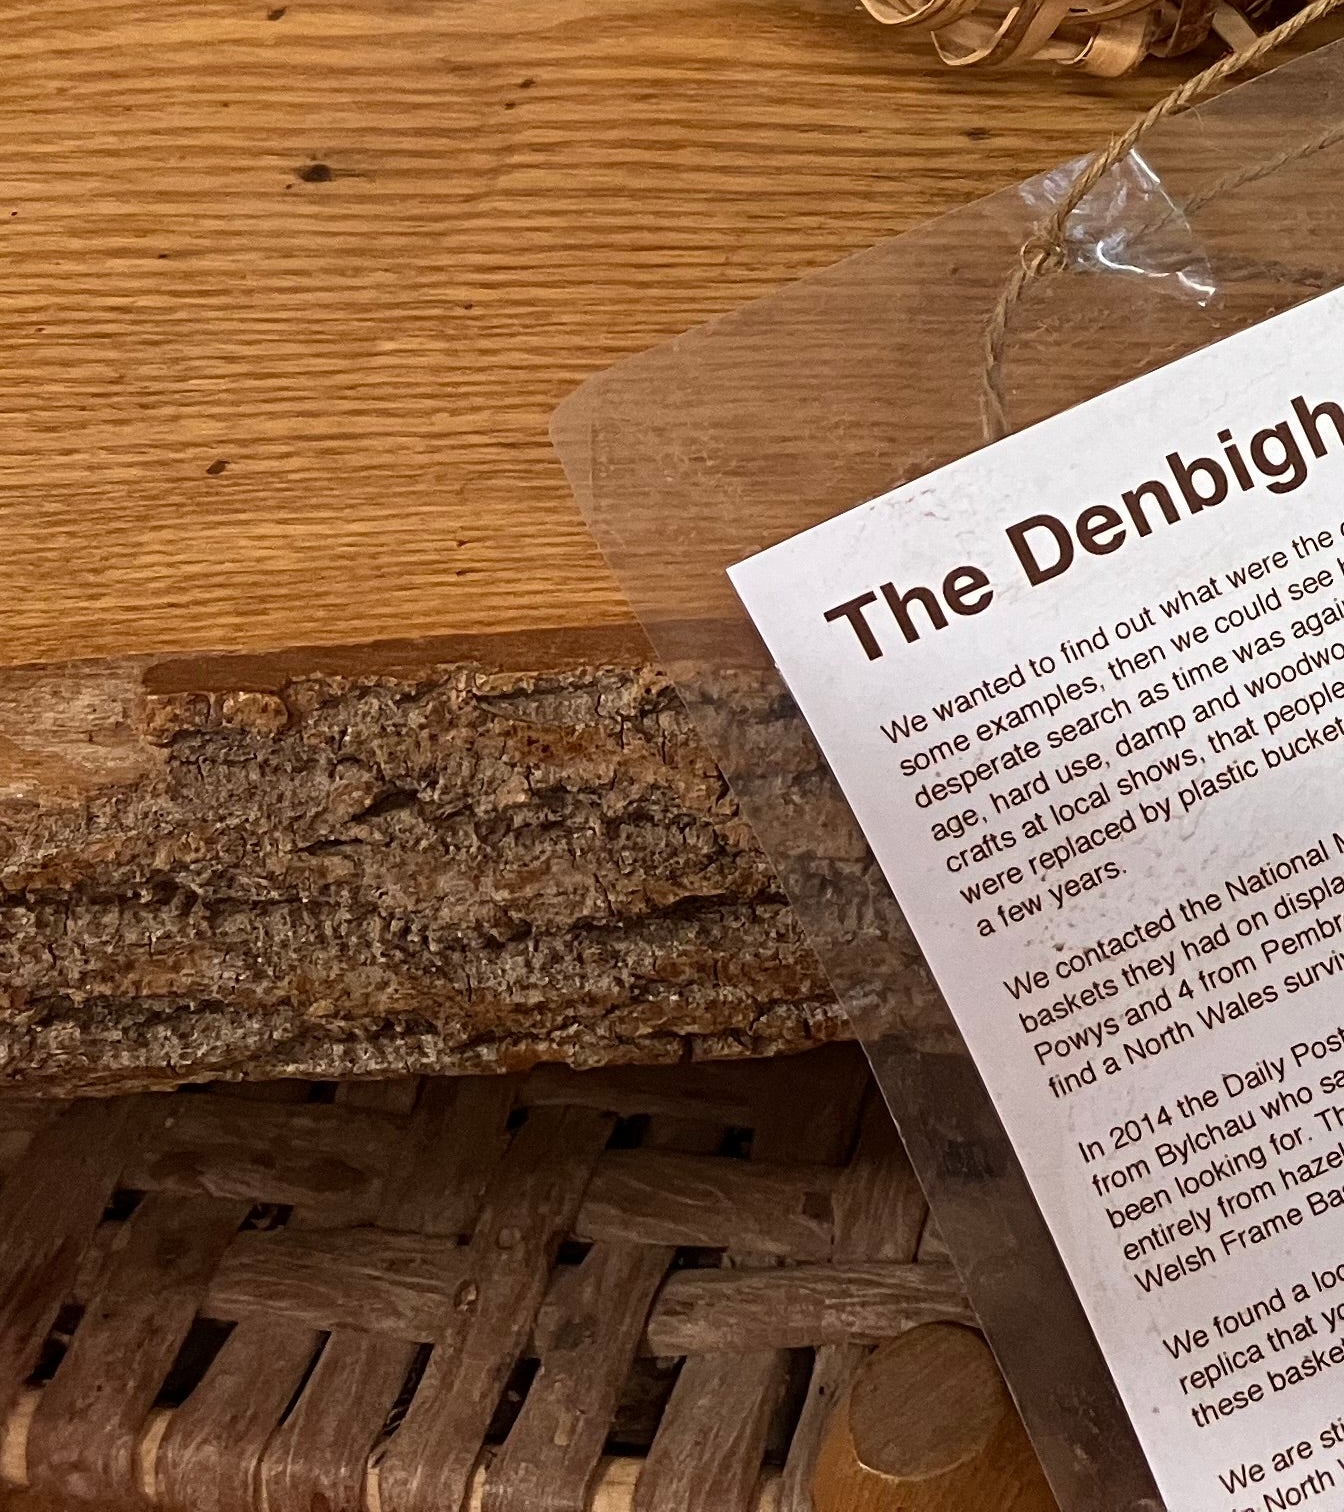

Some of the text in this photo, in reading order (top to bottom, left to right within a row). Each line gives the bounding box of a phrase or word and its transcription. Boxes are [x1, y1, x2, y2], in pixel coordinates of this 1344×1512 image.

[822, 564, 995, 663] The
[878, 713, 930, 745] We
[930, 662, 1028, 723] wanted
[1027, 654, 1057, 679] to
[1059, 624, 1111, 665] find
[1113, 605, 1158, 641] out
[1157, 576, 1225, 620] what
[1223, 550, 1290, 590] were
[1290, 529, 1335, 561] the
[913, 740, 1043, 810] desperate
[1045, 696, 1134, 750] search
[1136, 681, 1171, 709] as
[1170, 654, 1230, 693] time
[1230, 629, 1287, 665] was
[975, 860, 1128, 938] a few years.
[1001, 969, 1051, 1001] We
[1054, 906, 1178, 981] contacted
[1177, 892, 1224, 924] the
[1223, 838, 1333, 904] National
[1047, 1058, 1099, 1100] find
[1101, 1055, 1123, 1077] a
[1121, 1019, 1196, 1066] North
[1194, 983, 1280, 1031] Wales
[1077, 1139, 1107, 1165] In
[1108, 1103, 1174, 1153] 2014
[1175, 1088, 1221, 1120] the
[1220, 1055, 1286, 1100] Daily
[1103, 1187, 1174, 1231] been
[1173, 1143, 1269, 1200] looking
[1267, 1125, 1314, 1157] for.
[1132, 1244, 1218, 1294] Welsh
[1218, 1206, 1305, 1257] Frame
[1161, 1327, 1211, 1361] We
[1211, 1286, 1288, 1340] found
[1290, 1282, 1313, 1305] a
[1216, 1462, 1267, 1496] We
[1270, 1439, 1315, 1474] are
